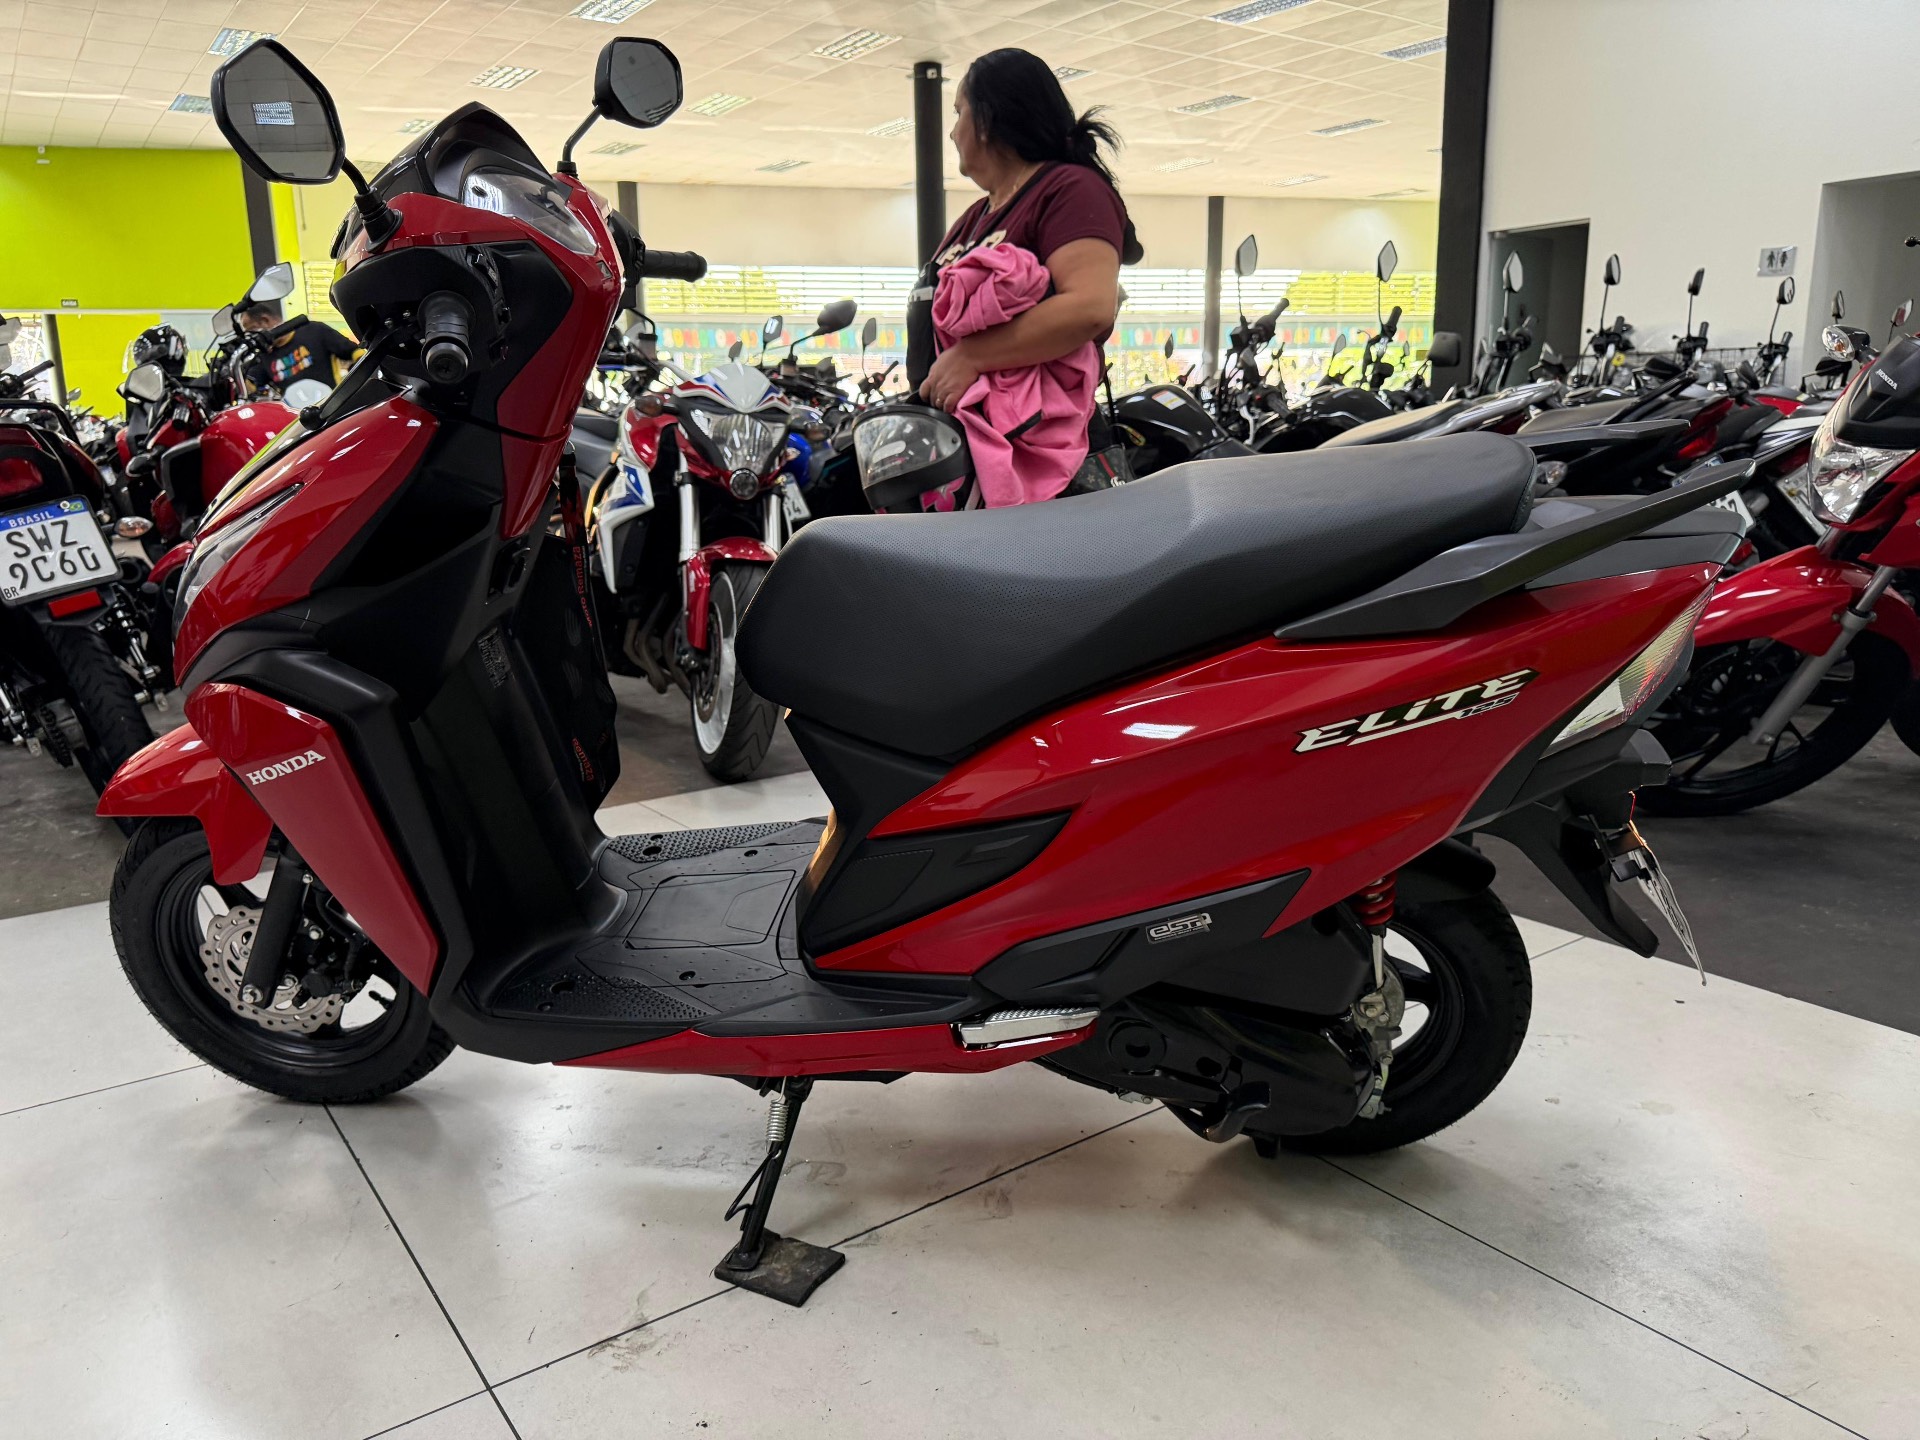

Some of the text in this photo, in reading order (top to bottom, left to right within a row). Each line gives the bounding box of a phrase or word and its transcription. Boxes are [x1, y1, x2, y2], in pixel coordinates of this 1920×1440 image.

[1875, 368, 1898, 390] HONDA
[8, 511, 54, 528] BRASIL
[5, 519, 78, 558] SWZ
[3, 586, 19, 599] BR
[1456, 691, 1520, 720] 125
[245, 749, 327, 786] HONDA
